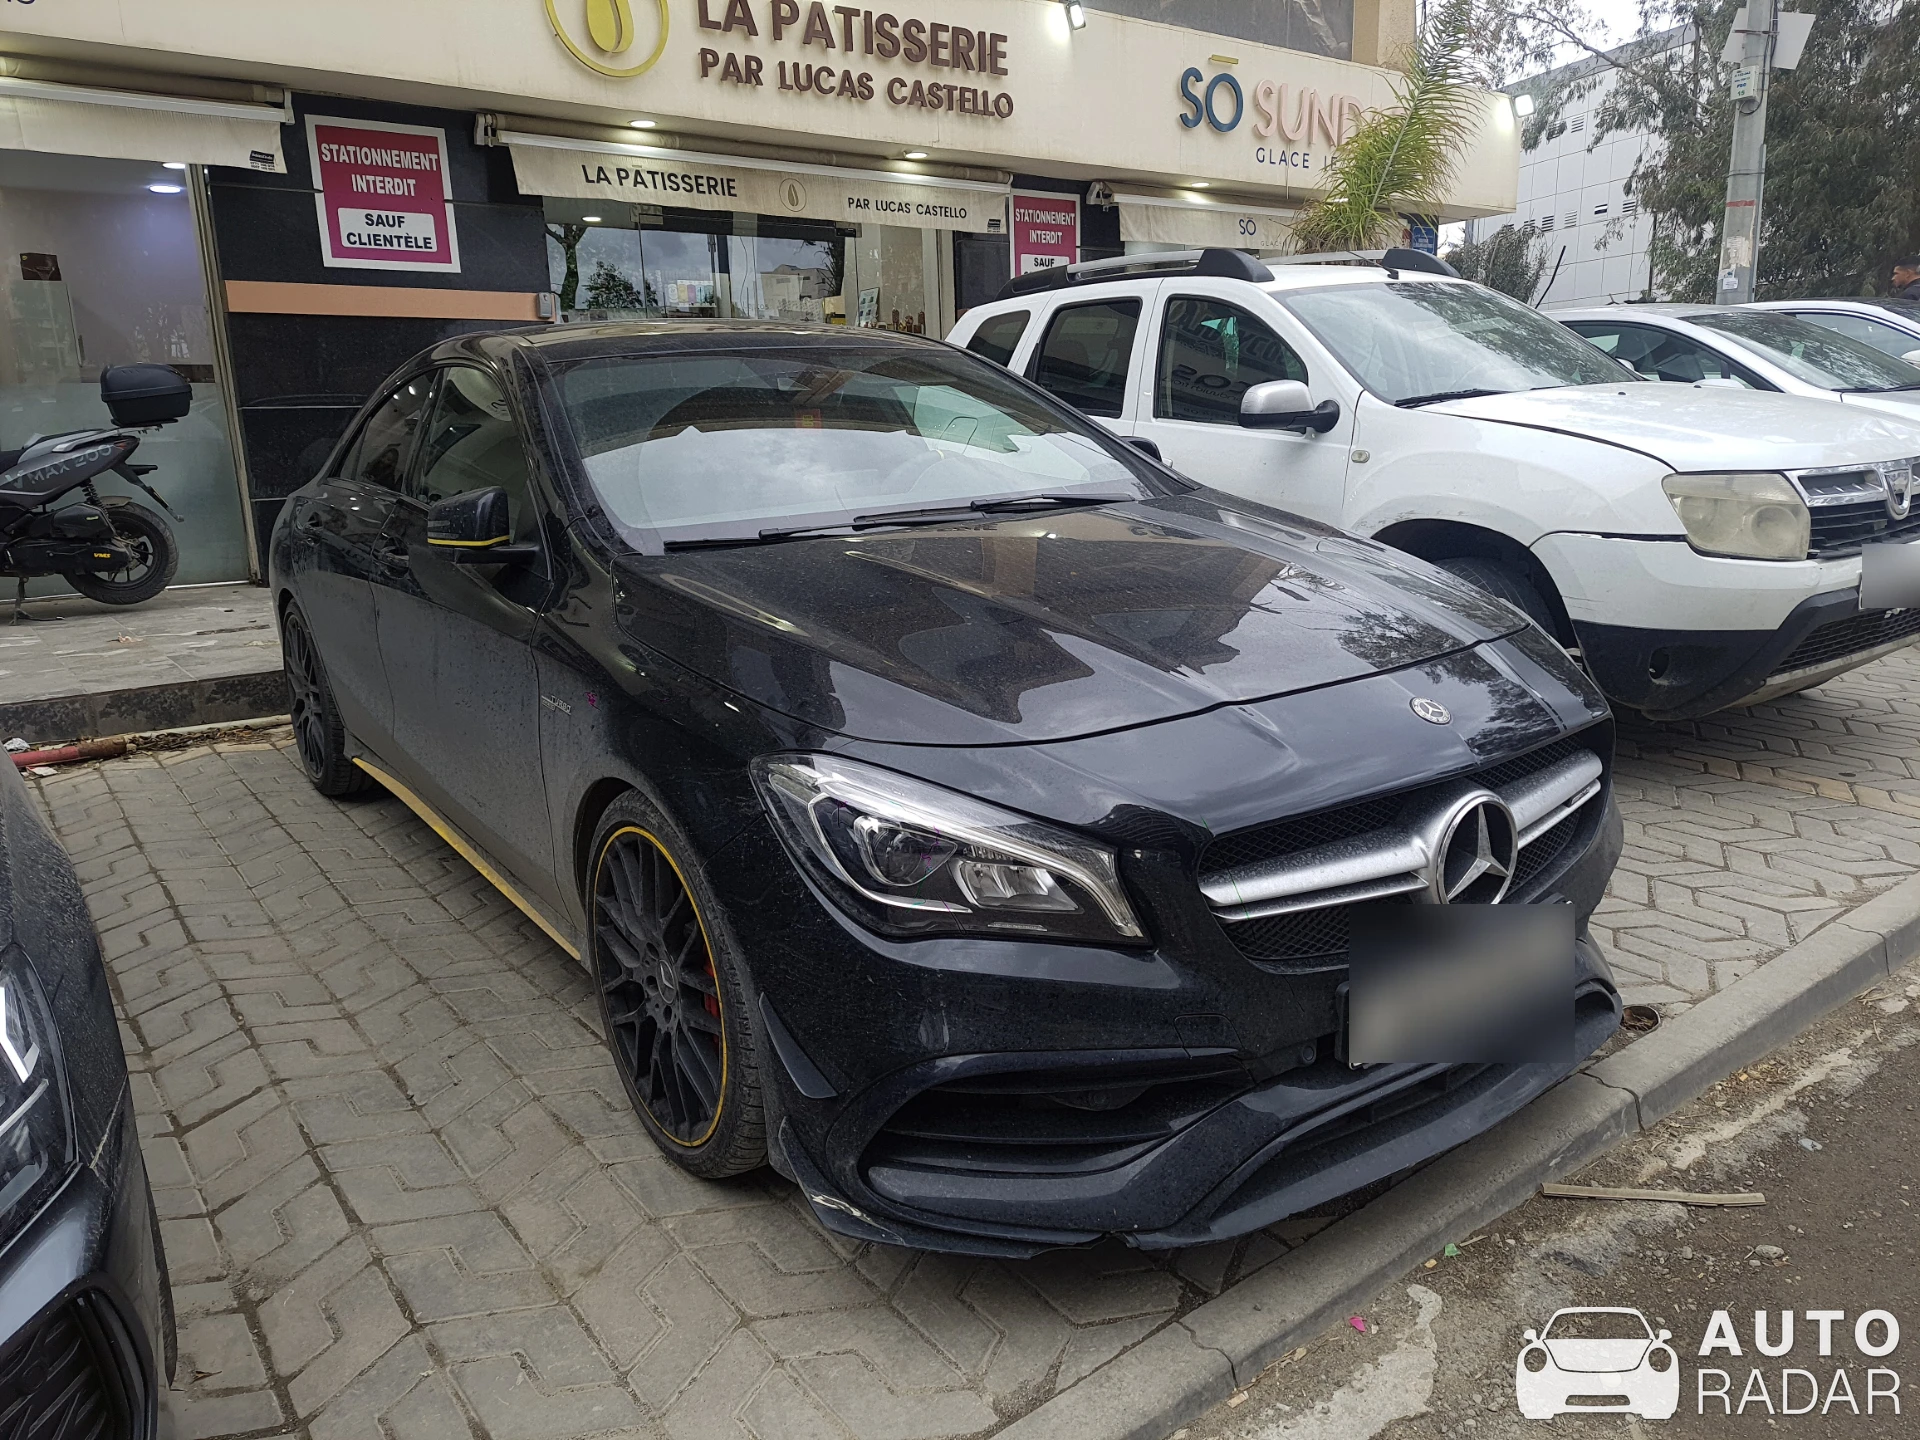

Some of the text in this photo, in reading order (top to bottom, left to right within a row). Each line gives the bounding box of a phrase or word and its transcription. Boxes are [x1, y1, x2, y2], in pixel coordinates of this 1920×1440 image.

[700, 0, 758, 36] LA
[699, 48, 1014, 118] PAR LUCAS CASTELLO
[321, 143, 438, 171] STATIONNEMENT
[1256, 147, 1310, 168] GLACE
[351, 174, 416, 196] INTERDIT
[581, 164, 612, 185] LA
[848, 197, 967, 218] PAR LUCAS CASTELLO
[1015, 208, 1075, 225] STATIONNEMENT
[364, 213, 405, 228] SAUF
[346, 232, 433, 249] CLIENTÈLE
[1029, 229, 1062, 244] INTERDIT
[1034, 257, 1055, 267] SAUF
[75, 444, 112, 468] 200
